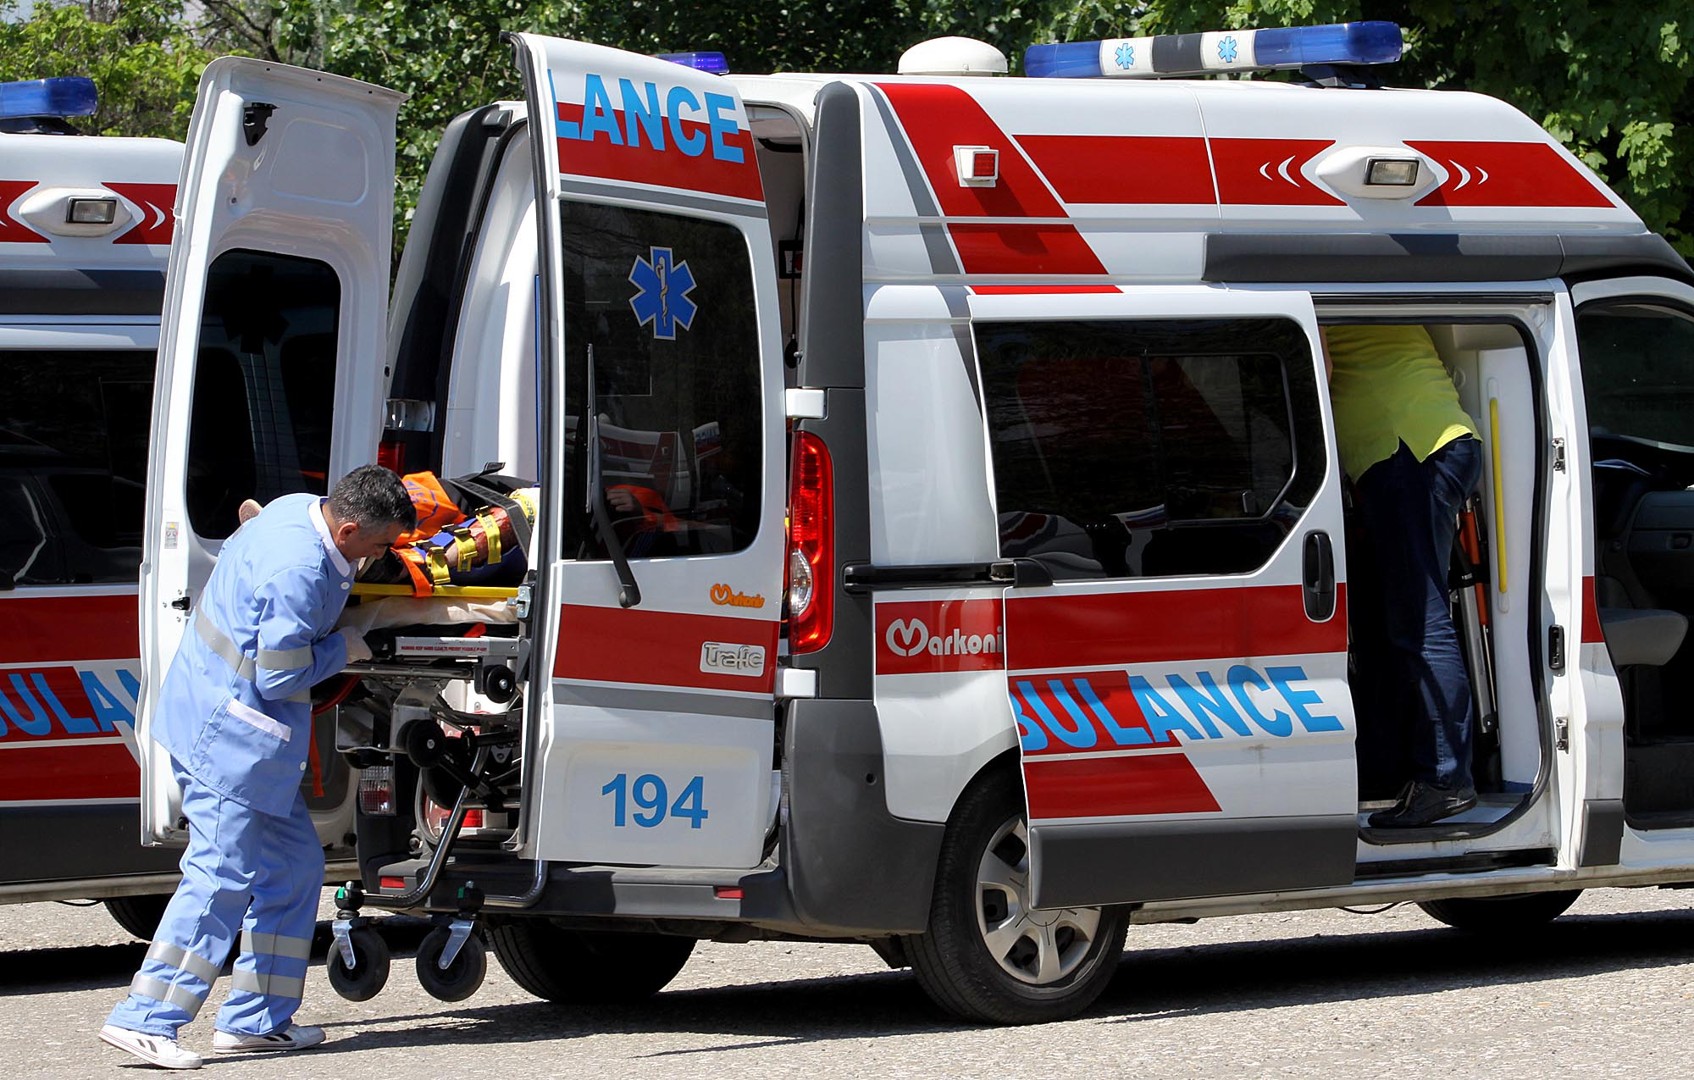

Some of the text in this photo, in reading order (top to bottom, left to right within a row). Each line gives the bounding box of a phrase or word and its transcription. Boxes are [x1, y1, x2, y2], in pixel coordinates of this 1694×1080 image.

[704, 643, 763, 669] Trafic
[0, 669, 140, 736] ULA
[602, 774, 708, 828] 194
